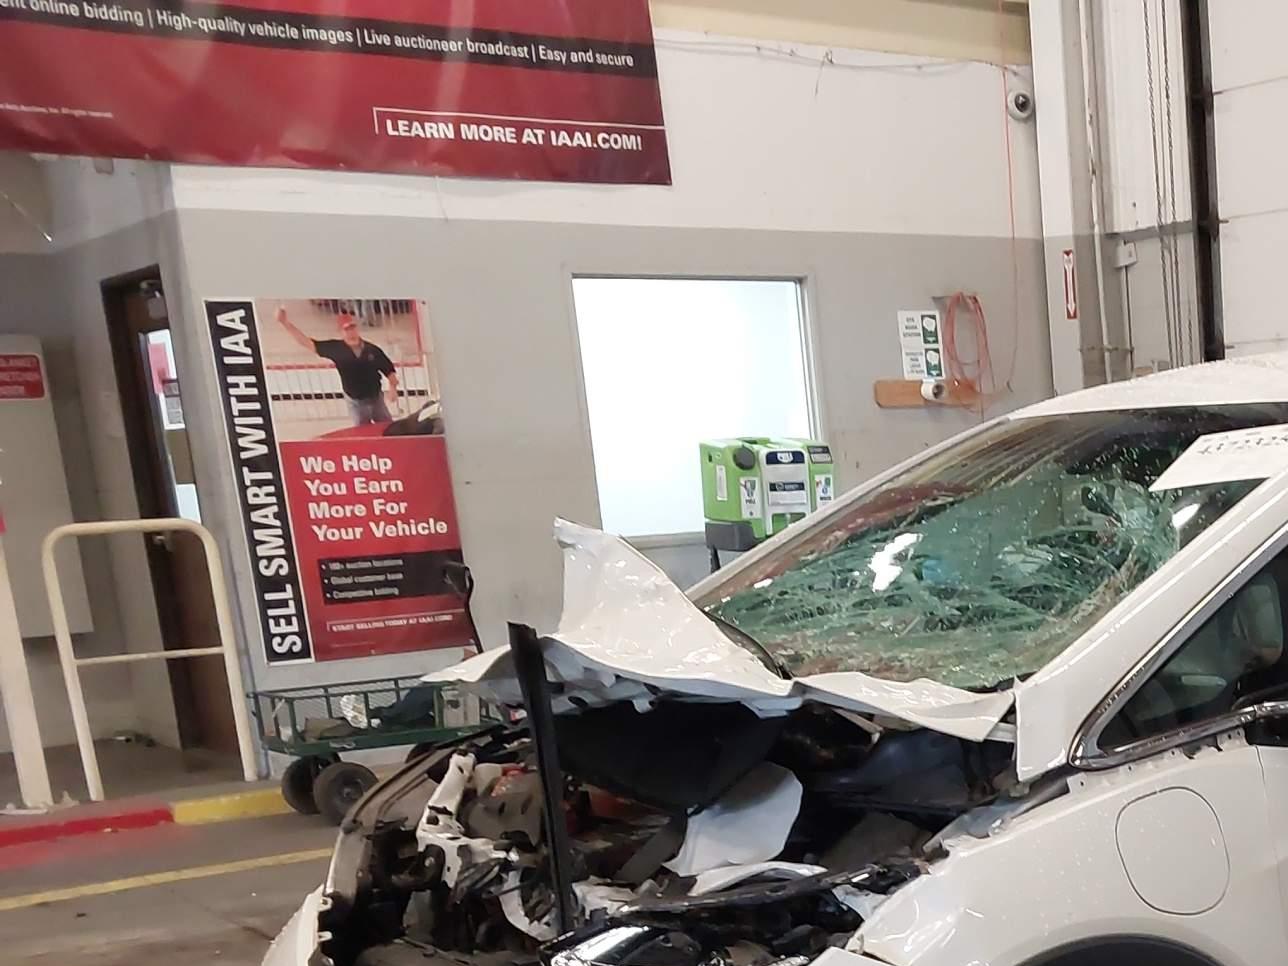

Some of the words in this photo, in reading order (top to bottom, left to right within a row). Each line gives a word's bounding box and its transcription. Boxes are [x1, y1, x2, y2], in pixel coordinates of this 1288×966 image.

[84, 3, 145, 27] bidding
[156, 9, 246, 37] High-quality
[248, 22, 299, 40] vehicle
[301, 24, 353, 45] images
[364, 28, 391, 46] Live
[393, 34, 464, 52] auctioneer
[466, 37, 530, 59] broadcast
[539, 45, 567, 65] Easy
[570, 49, 594, 64] and
[595, 52, 634, 68] secure
[386, 119, 454, 140] LEARN
[460, 123, 517, 144] MORE
[521, 129, 546, 145] AT
[550, 131, 642, 151] IAAI.COM!
[216, 308, 254, 365] IAA
[226, 375, 269, 460] WITH
[299, 456, 336, 474] We
[341, 454, 393, 474] Help
[304, 479, 347, 496] You
[353, 477, 404, 494] Earn
[242, 466, 289, 577] SMART
[308, 502, 367, 519] More
[372, 499, 408, 516] For
[311, 524, 363, 541] Your
[368, 518, 448, 538] Vehicle
[271, 583, 302, 655] SELL
